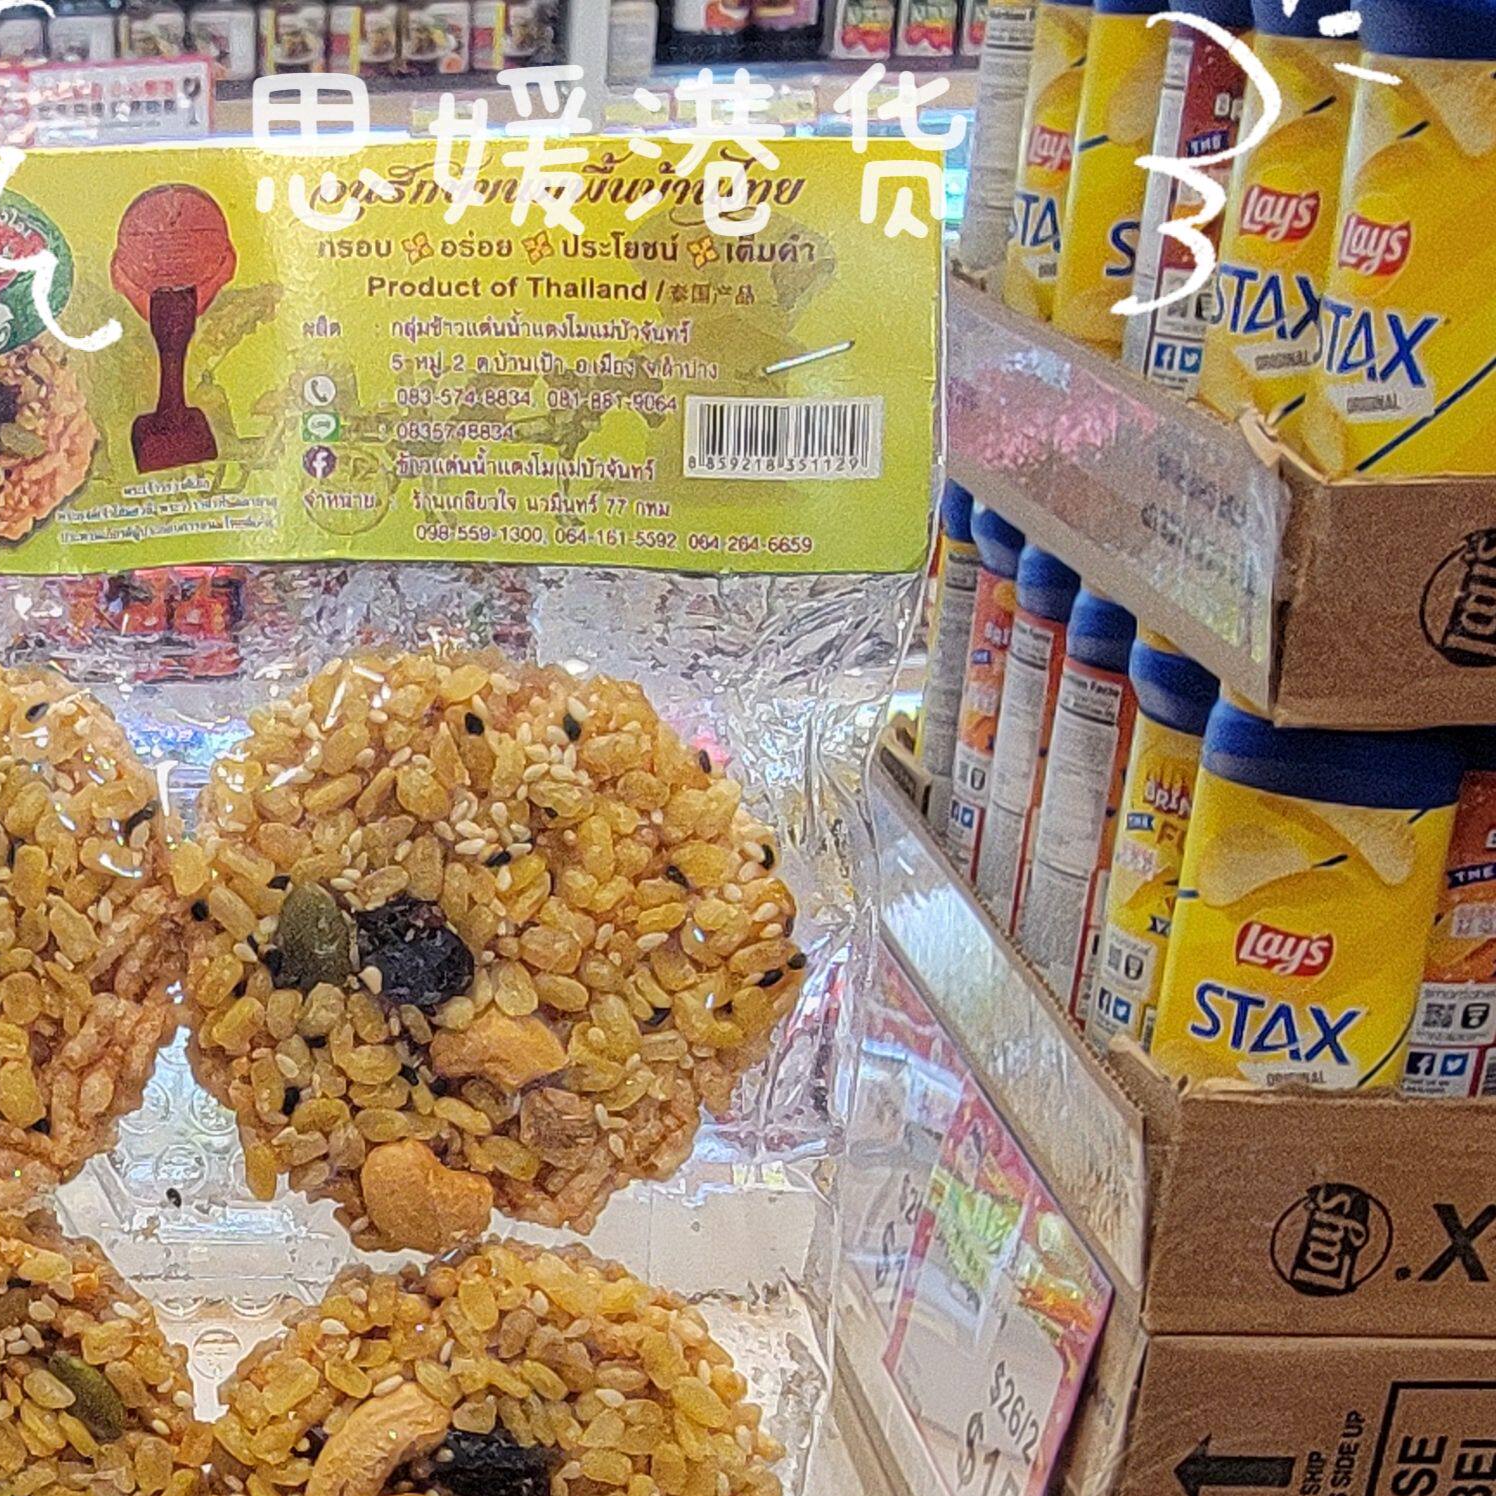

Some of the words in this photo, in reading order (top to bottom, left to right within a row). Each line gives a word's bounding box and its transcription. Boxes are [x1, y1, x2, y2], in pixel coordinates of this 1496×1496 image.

[441, 230, 513, 258] อร่อย
[368, 276, 481, 298] Product
[490, 276, 519, 298] of
[526, 276, 647, 300] Thailand
[1190, 982, 1362, 1066] STAX
[1343, 1410, 1366, 1440] UP
[1330, 1440, 1360, 1490] SIDE
